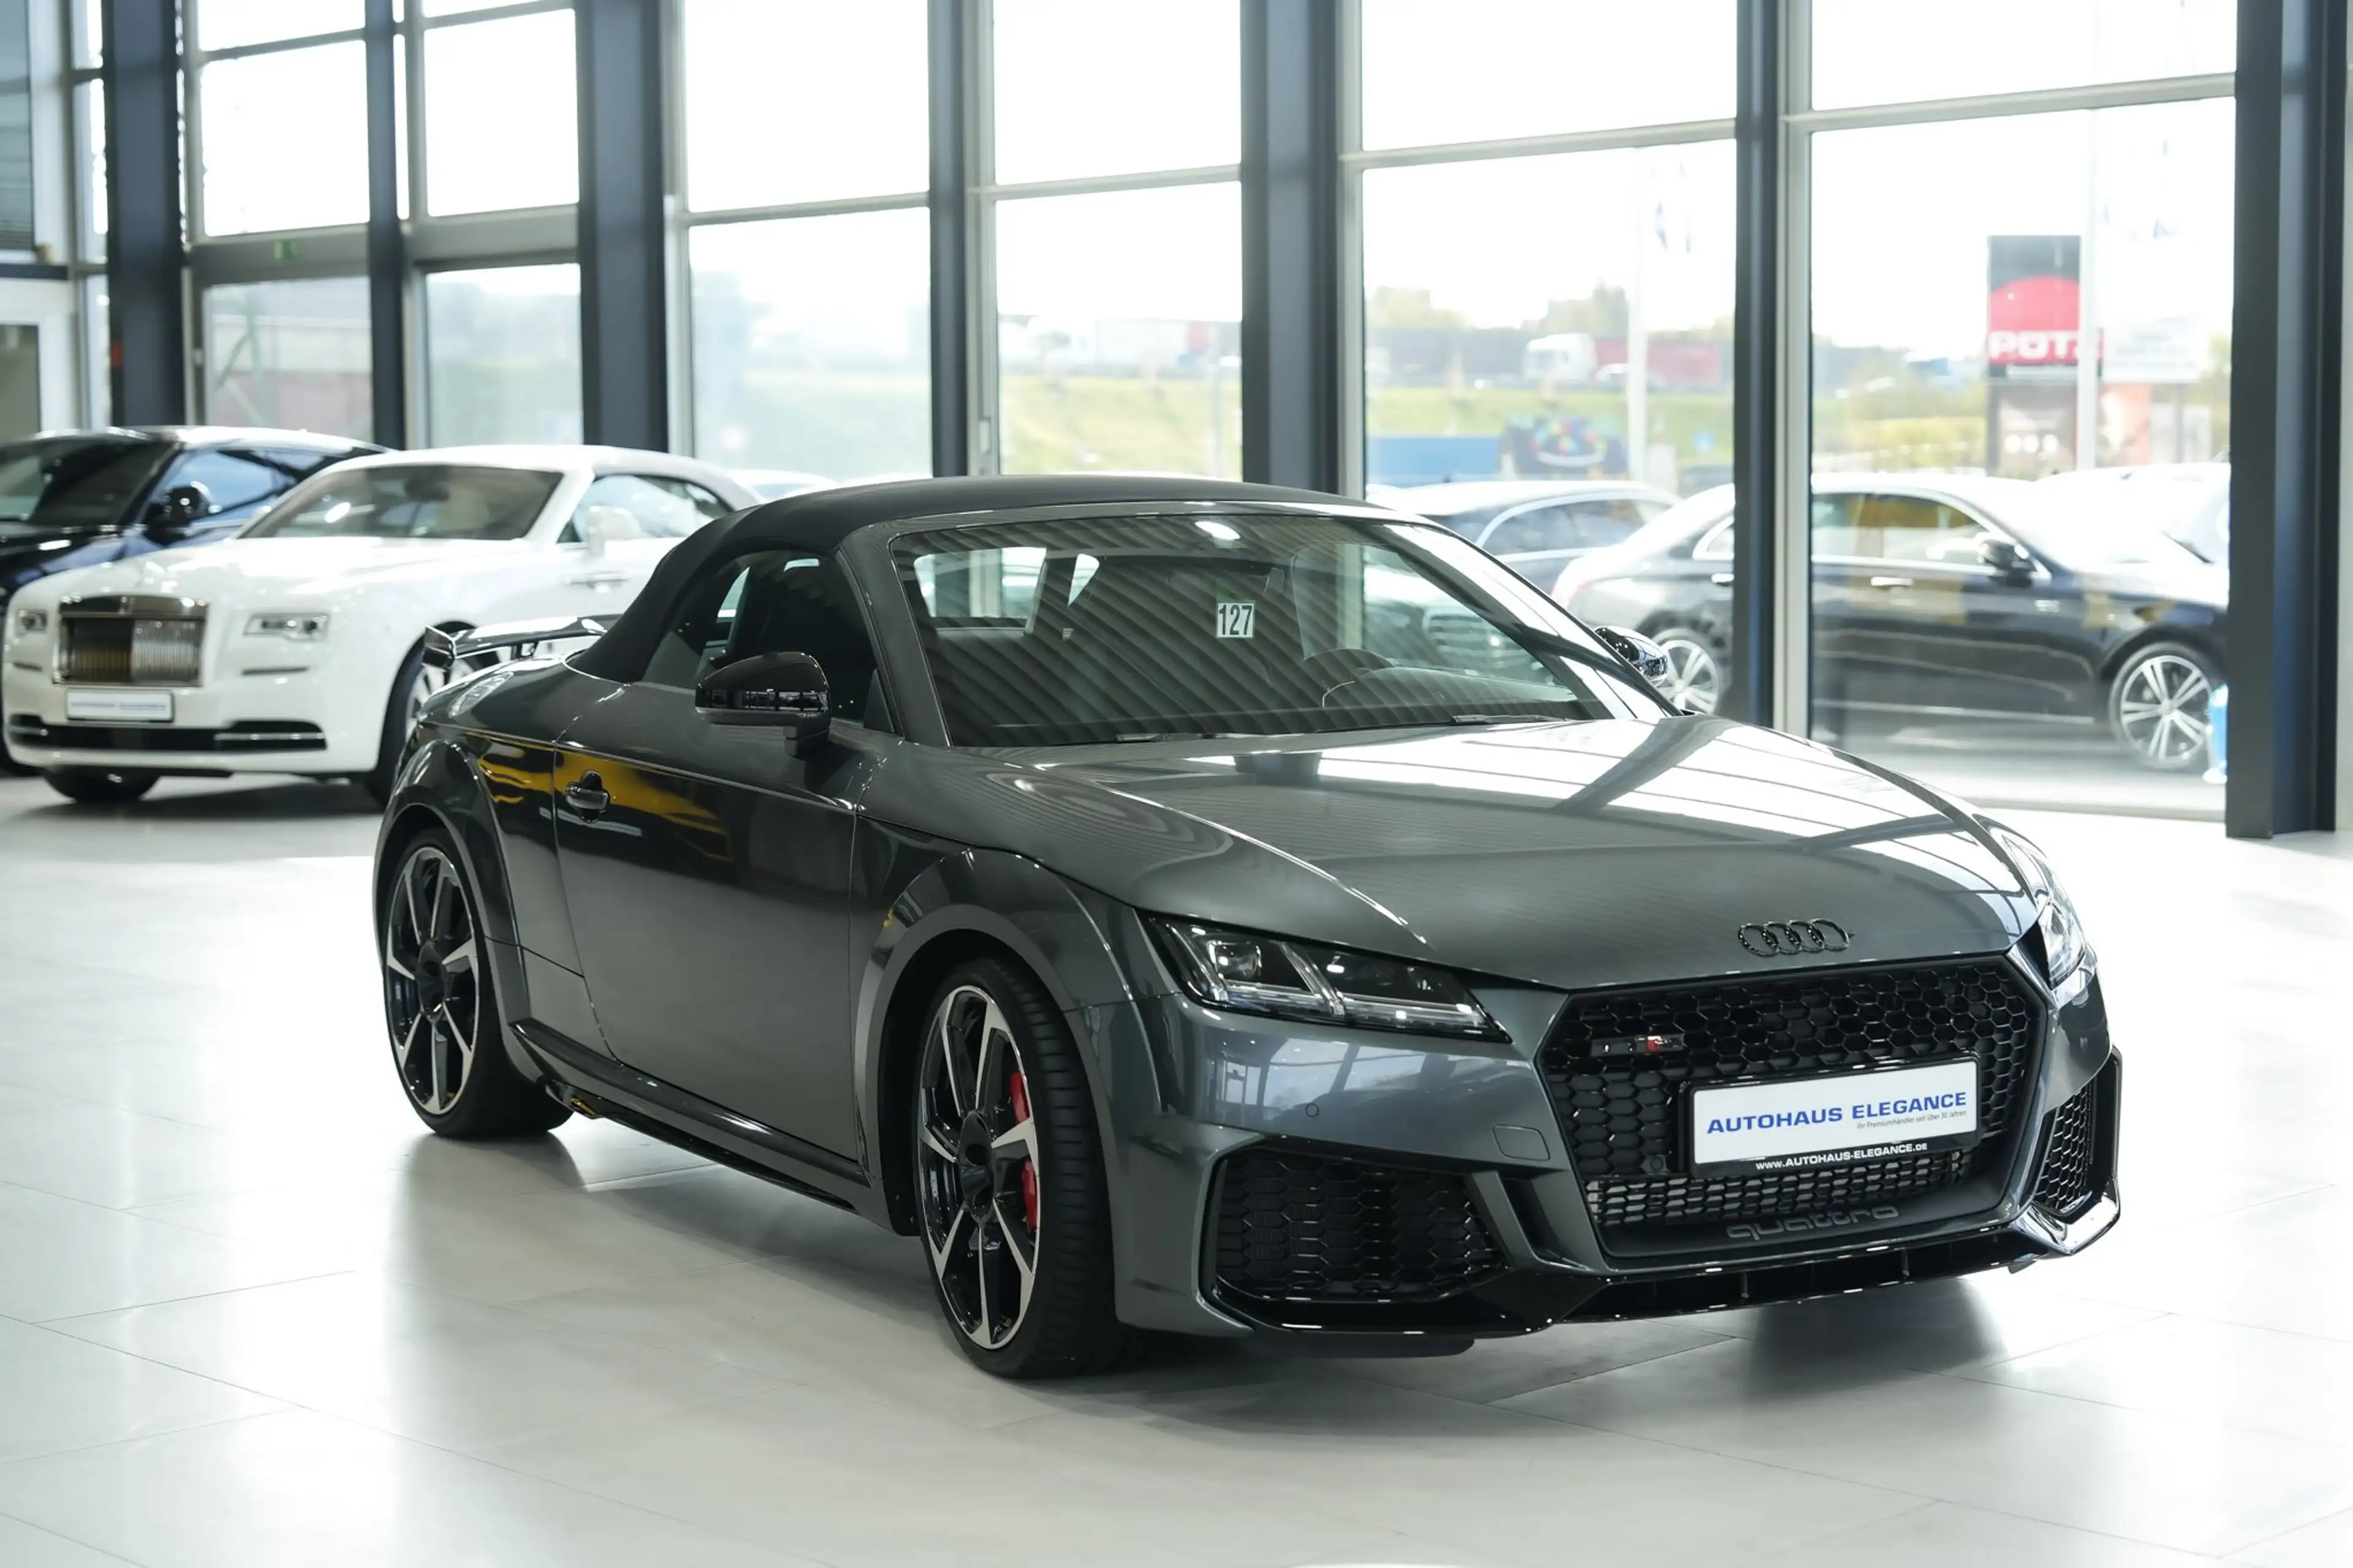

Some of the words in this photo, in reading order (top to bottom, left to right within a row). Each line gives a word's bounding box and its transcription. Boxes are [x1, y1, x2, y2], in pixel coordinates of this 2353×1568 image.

[1219, 604, 1252, 635] 127
[1707, 1107, 1843, 1134] AUTOHAUS
[1852, 1092, 1966, 1119] ELEGANCE
[1949, 1110, 1966, 1119] Jahren
[1726, 1206, 1899, 1240] quattro
